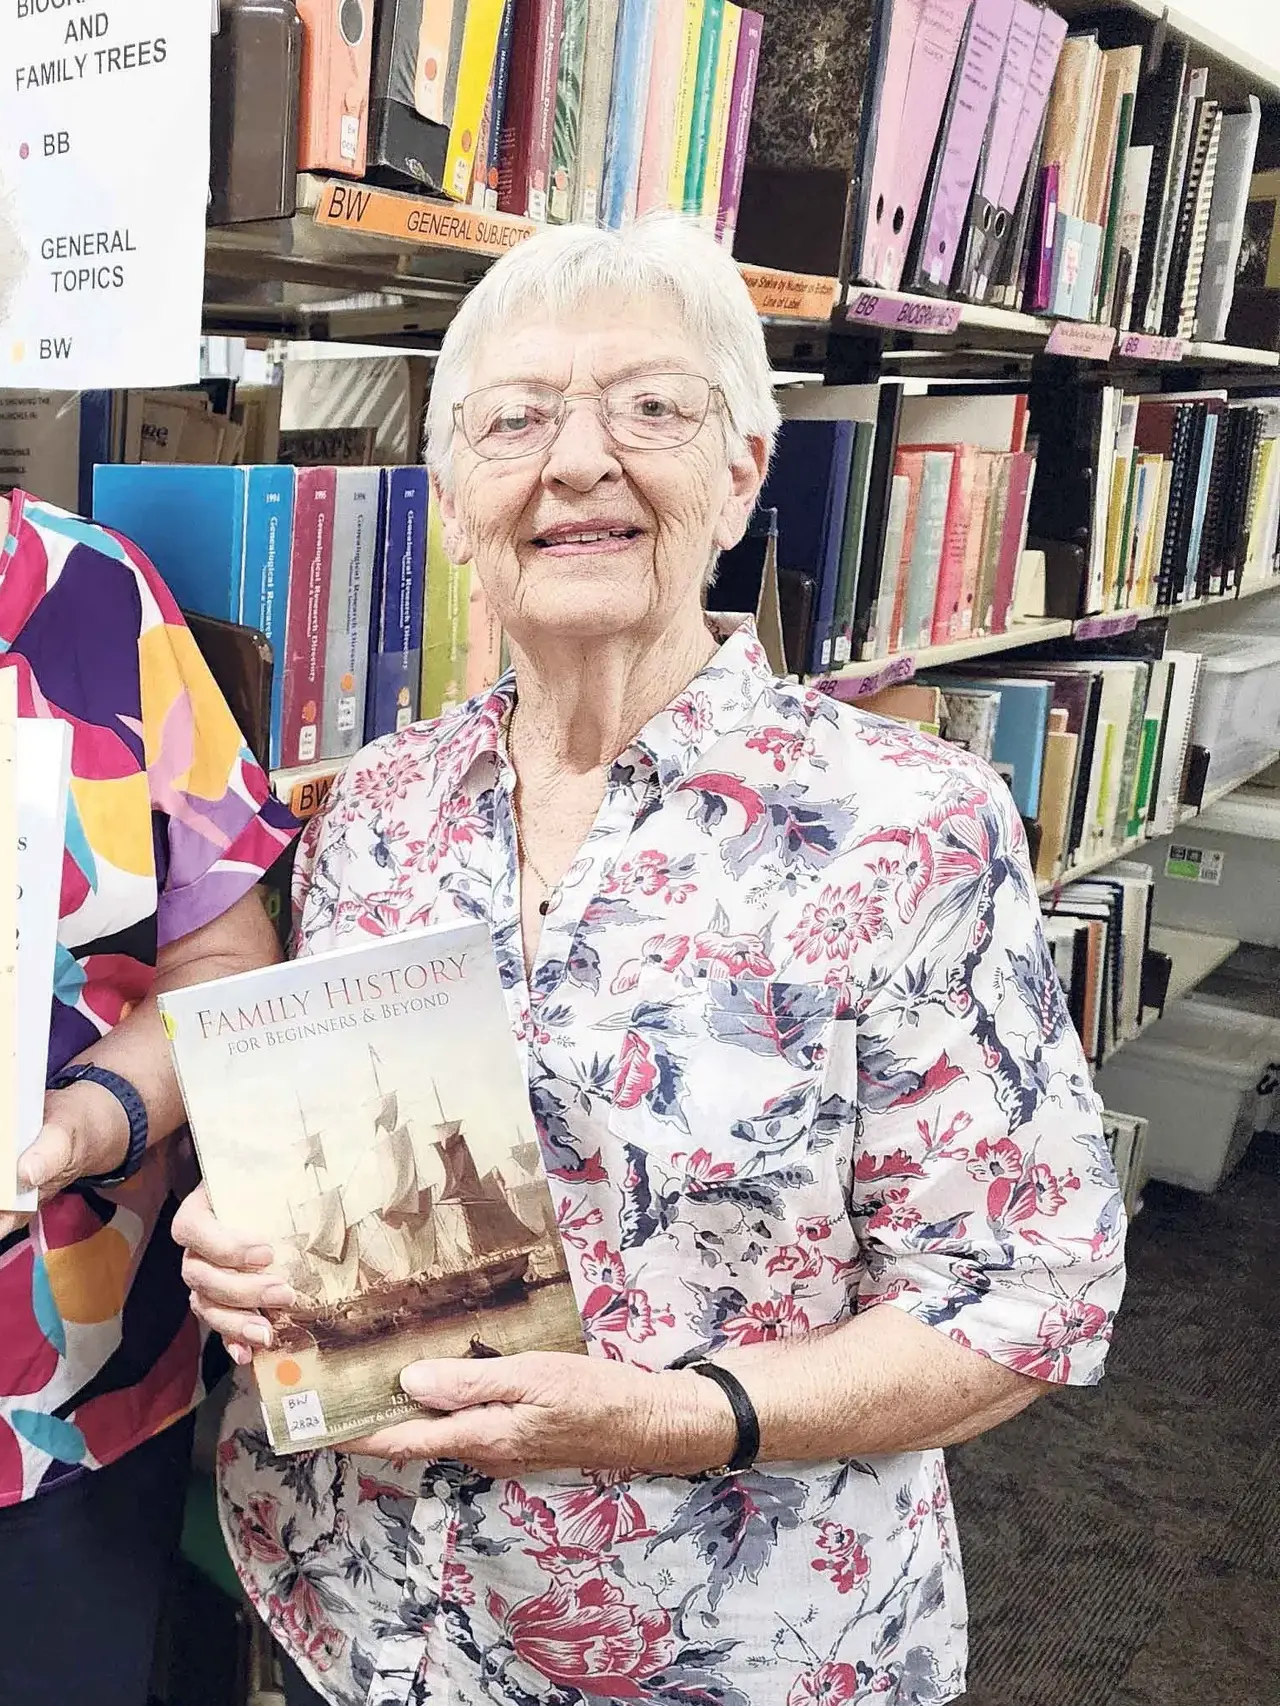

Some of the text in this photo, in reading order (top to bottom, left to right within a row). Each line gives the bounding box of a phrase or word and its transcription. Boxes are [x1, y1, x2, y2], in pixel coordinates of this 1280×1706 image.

[64, 12, 109, 44] AND
[16, 38, 167, 92] FAMILY TREES
[43, 131, 70, 156] BB
[540, 98, 550, 152] Directory
[328, 187, 371, 222] BW
[407, 210, 471, 239] GENERAL
[41, 229, 136, 260] GENERAL
[51, 265, 124, 292] TOPICS
[856, 293, 878, 316] BB
[39, 337, 72, 359] BW
[265, 516, 279, 639] Genealogical Research
[307, 513, 325, 683] Genealogical Research Directory
[401, 509, 415, 670] Genealogical Research Directory
[195, 953, 468, 1039] FAMILY HISTORY
[227, 992, 450, 1055] FOR BEGINNERS & BEYOND
[288, 1395, 308, 1409] BW
[290, 1416, 320, 1432] 2823
